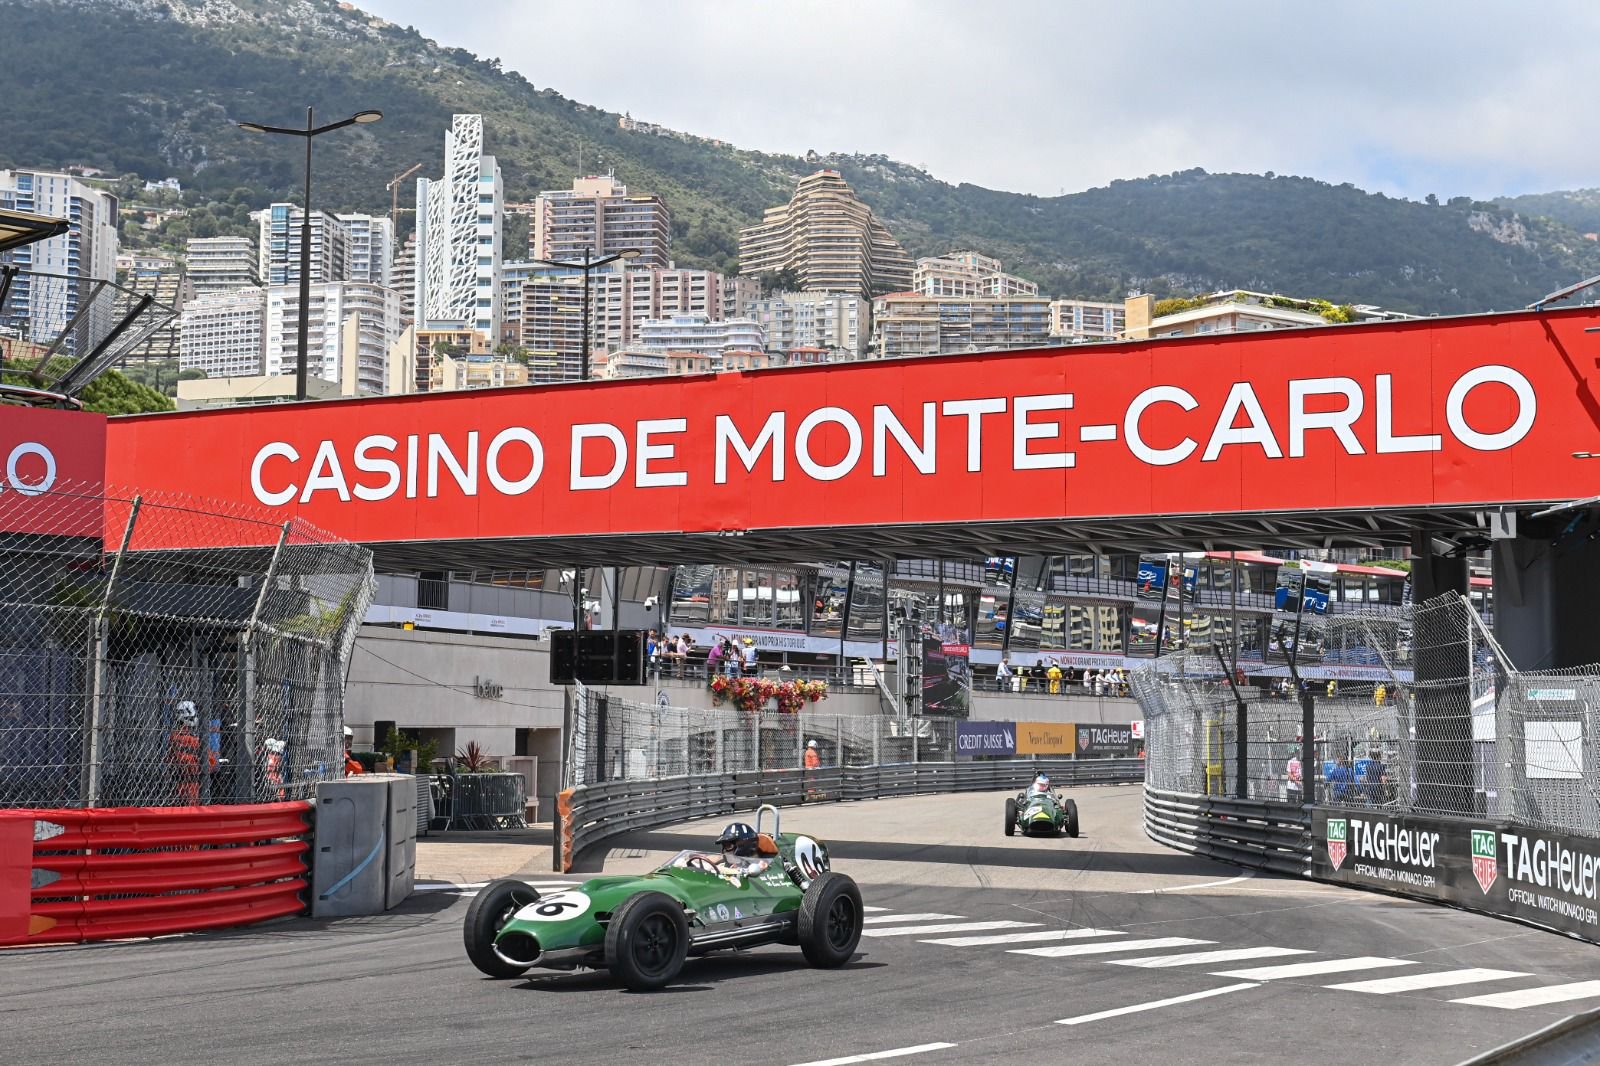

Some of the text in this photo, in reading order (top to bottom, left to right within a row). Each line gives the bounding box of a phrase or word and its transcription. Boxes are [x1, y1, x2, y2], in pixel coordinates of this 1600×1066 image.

[250, 366, 1537, 506] CASINO DE MONTE-CARLO
[959, 734, 1003, 749] CREDIT SUISSE
[1329, 823, 1345, 838] TAG
[1474, 834, 1494, 855] TAG
[1354, 863, 1436, 888] OFFICIAL WATCH MONACO GPH
[1473, 858, 1496, 889] HEUER
[1508, 888, 1598, 925] OFFICIAL WATCH MONACO GPH
